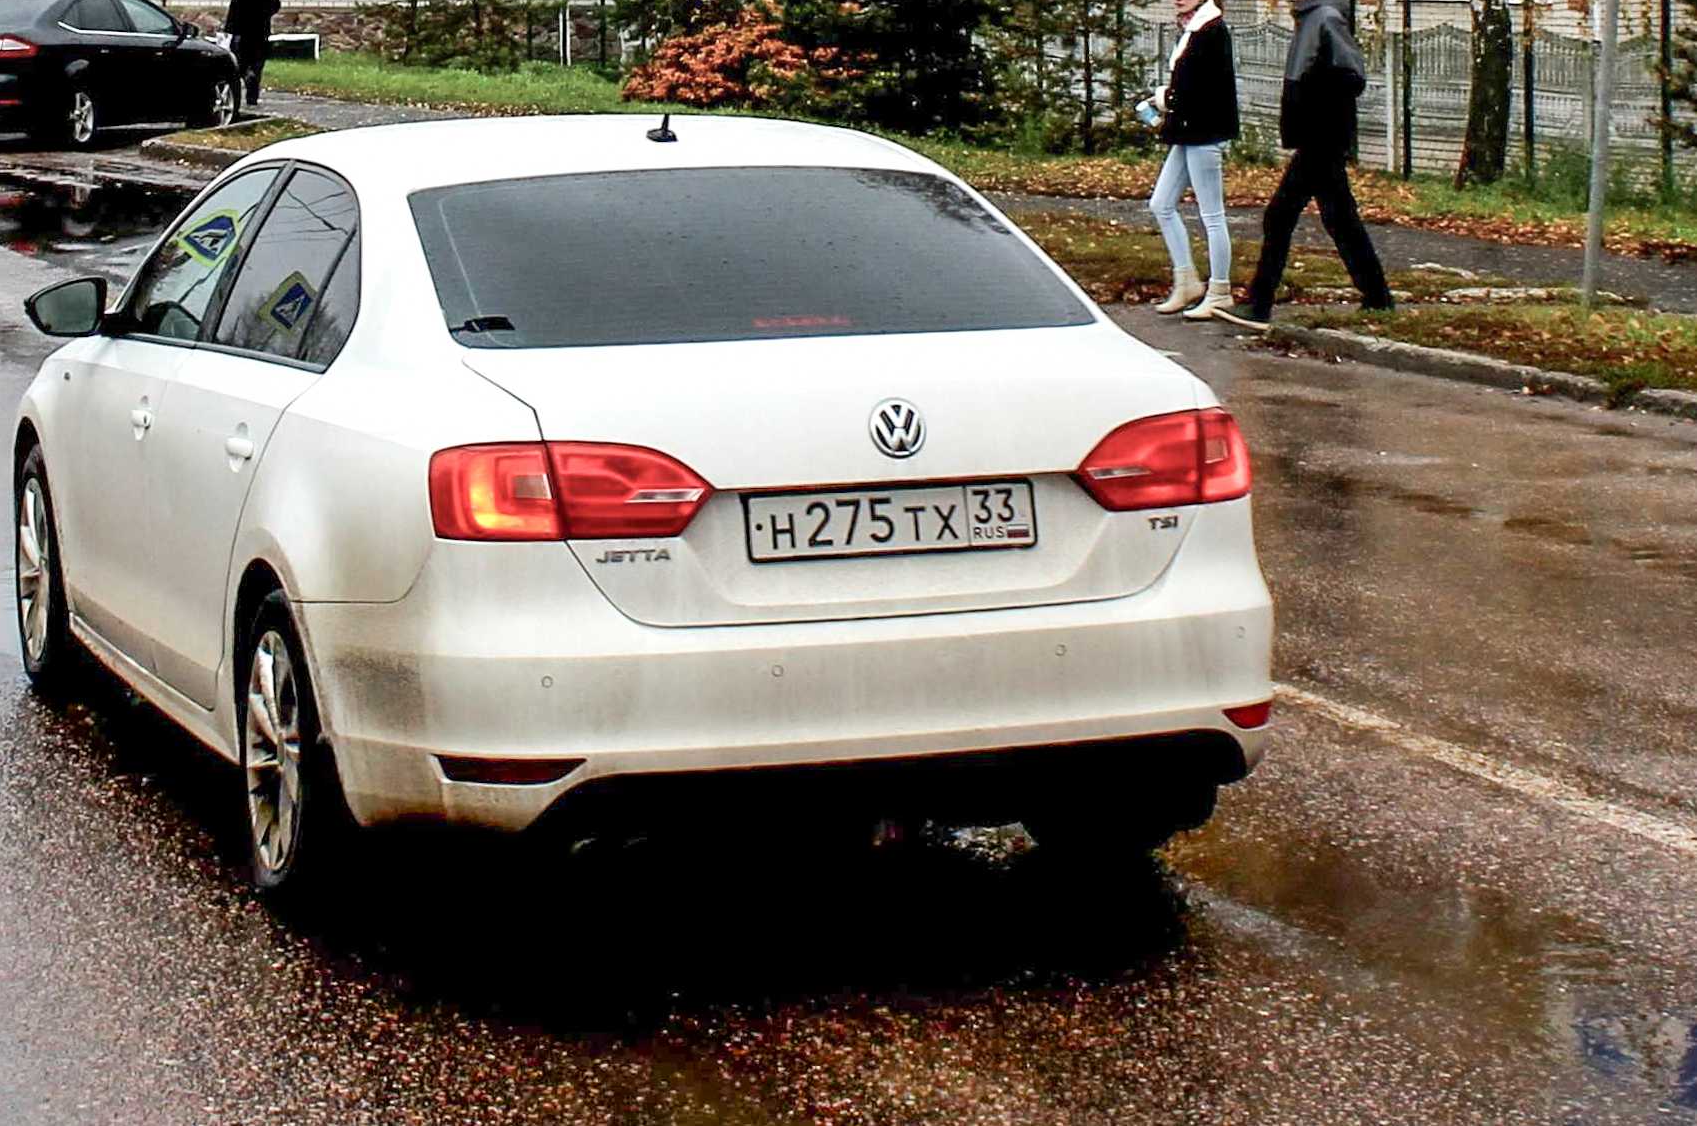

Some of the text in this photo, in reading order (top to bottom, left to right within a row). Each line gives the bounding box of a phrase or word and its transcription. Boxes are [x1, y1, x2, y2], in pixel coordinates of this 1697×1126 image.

[972, 488, 1015, 524] 33
[1148, 515, 1179, 530] TSI
[974, 526, 1005, 539] RUS
[596, 548, 671, 564] JETTA
